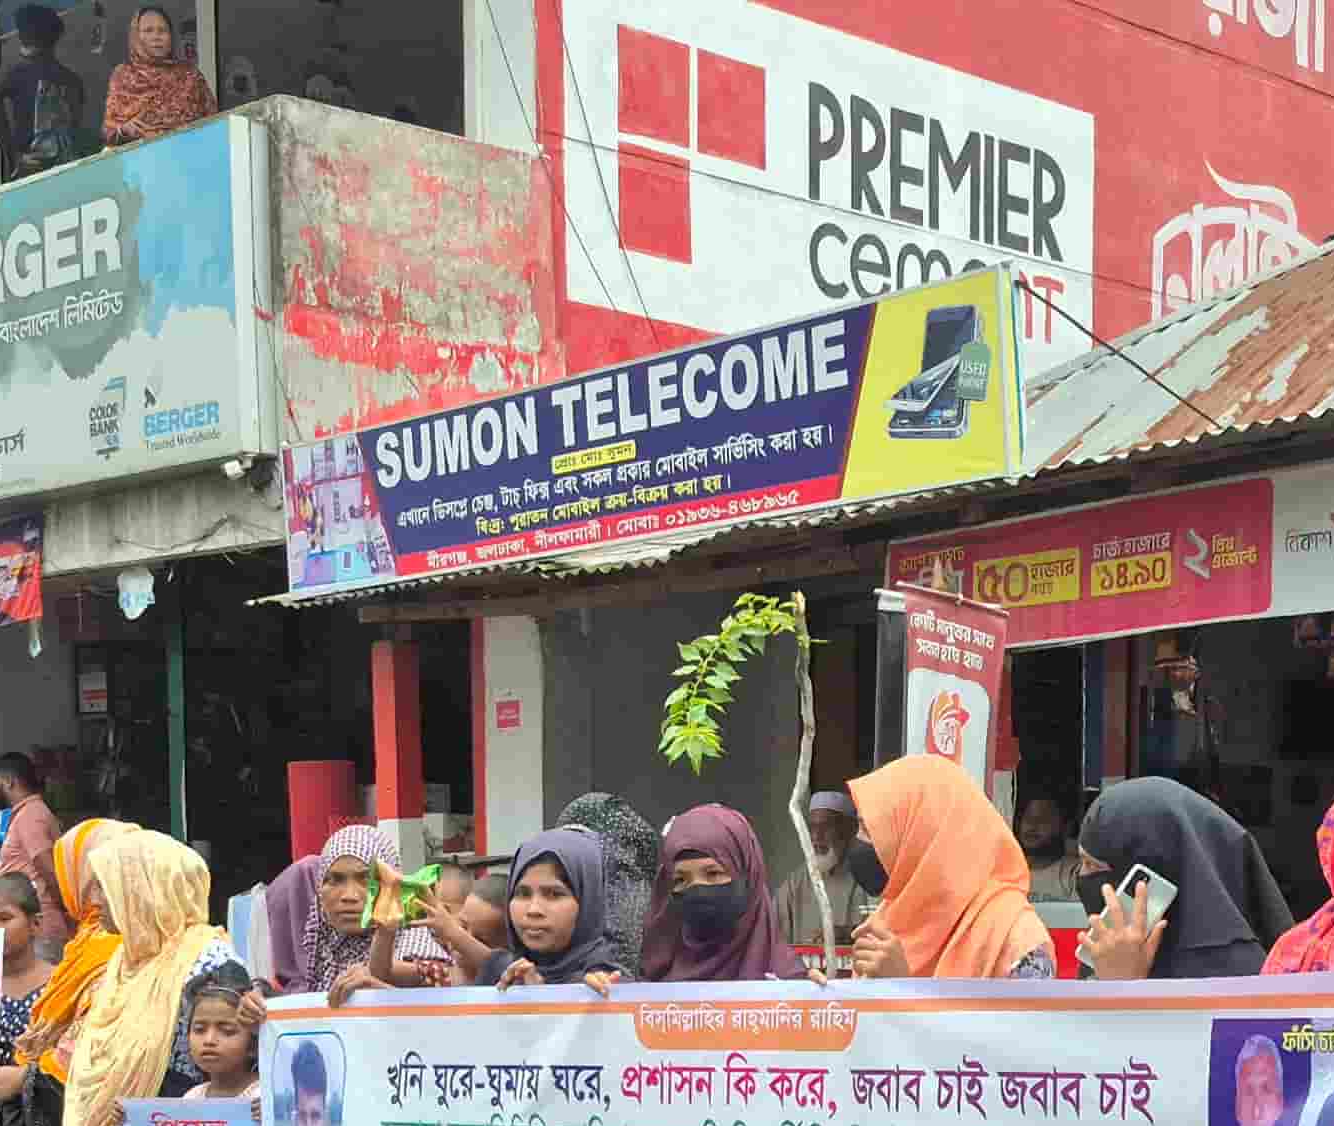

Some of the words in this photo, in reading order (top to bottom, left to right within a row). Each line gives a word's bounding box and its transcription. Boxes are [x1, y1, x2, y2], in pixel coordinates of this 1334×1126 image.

[809, 81, 1066, 262] PREMIER
[63, 290, 124, 328] লিমিটেড
[145, 401, 220, 436] BERGER
[375, 399, 539, 489] SUMON
[551, 319, 850, 449] TELECOME
[396, 507, 430, 529] এখানে
[617, 460, 651, 483] প্রকার
[655, 447, 709, 476] মোবাইল
[713, 432, 767, 464] সার্ভিসিং
[767, 430, 797, 451] করা
[553, 497, 601, 522] মোবাইল
[673, 477, 698, 497] করা
[1284, 528, 1333, 554] বিকাশ
[809, 1001, 857, 1034] রাহিম
[387, 1051, 425, 1109] খুনি
[433, 1060, 542, 1110] ঘুরে-ঘুমায়
[551, 1064, 611, 1113] ঘরে,
[620, 1061, 714, 1107] প্রশাসন
[722, 1052, 761, 1107] কি
[768, 1064, 839, 1120] করে,
[850, 1066, 924, 1121] জবাব
[935, 1060, 987, 1118] চাই
[998, 1068, 1087, 1123] জবাব
[1095, 1056, 1160, 1124] চাই
